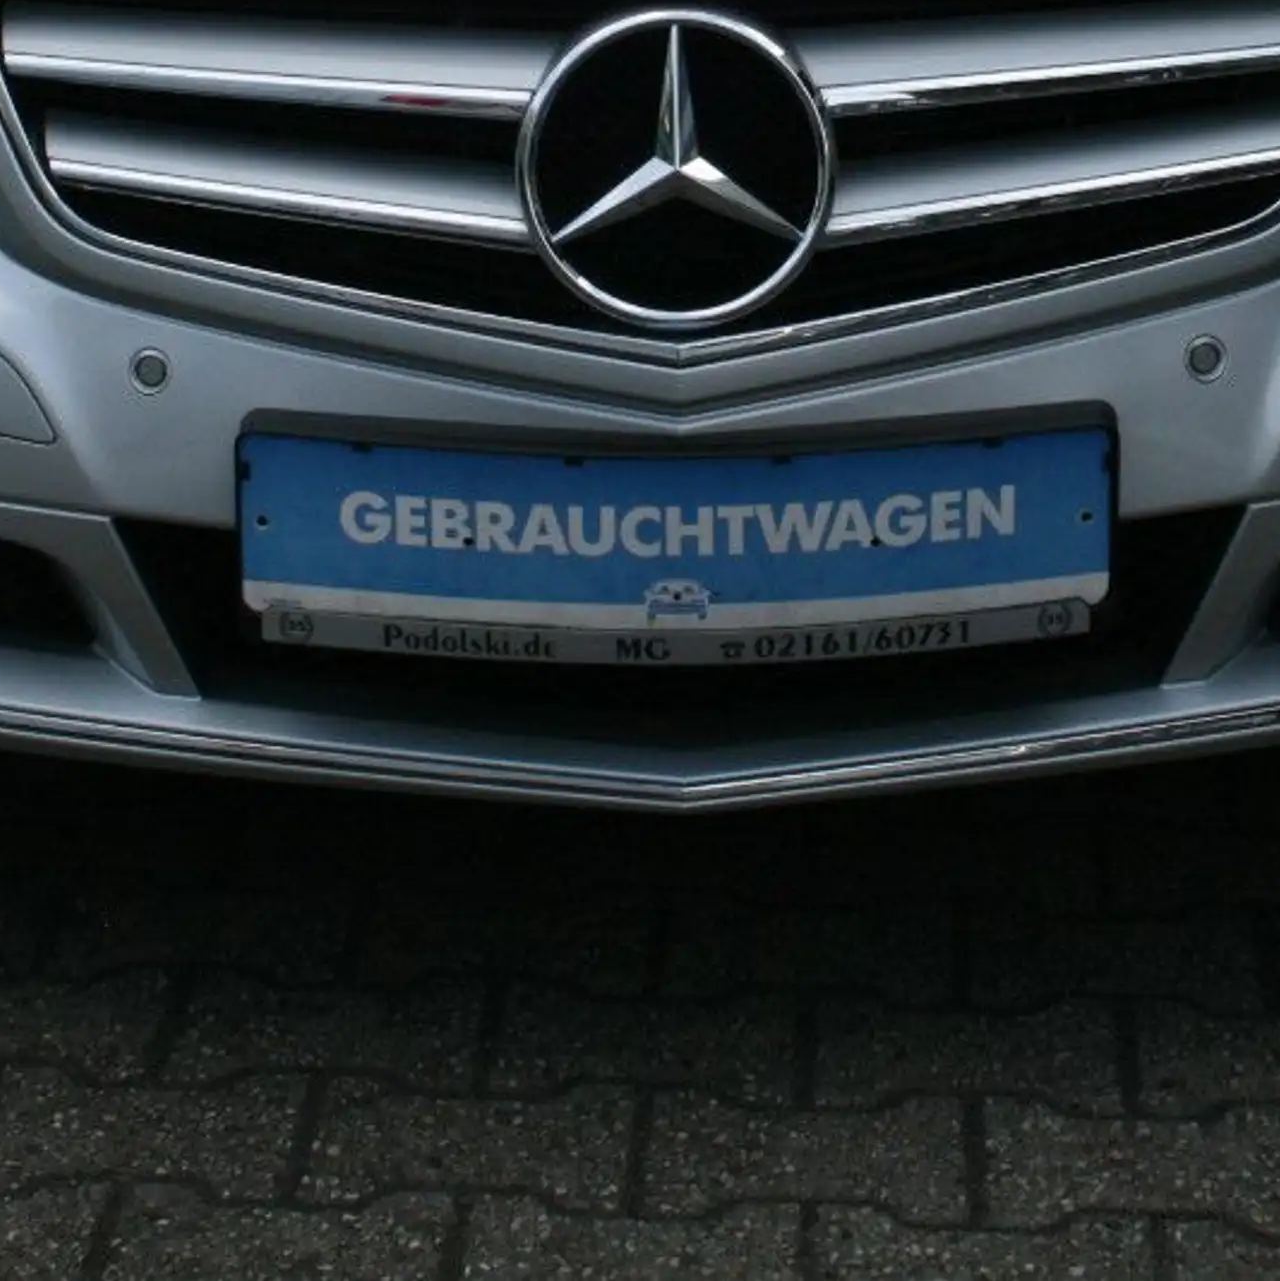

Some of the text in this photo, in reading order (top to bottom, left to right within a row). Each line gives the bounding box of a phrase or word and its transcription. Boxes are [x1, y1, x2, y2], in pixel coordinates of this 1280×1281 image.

[339, 484, 1016, 557] GEBRAUCHTWAGEN
[382, 622, 557, 659] Podolski.de
[616, 636, 671, 661] MG
